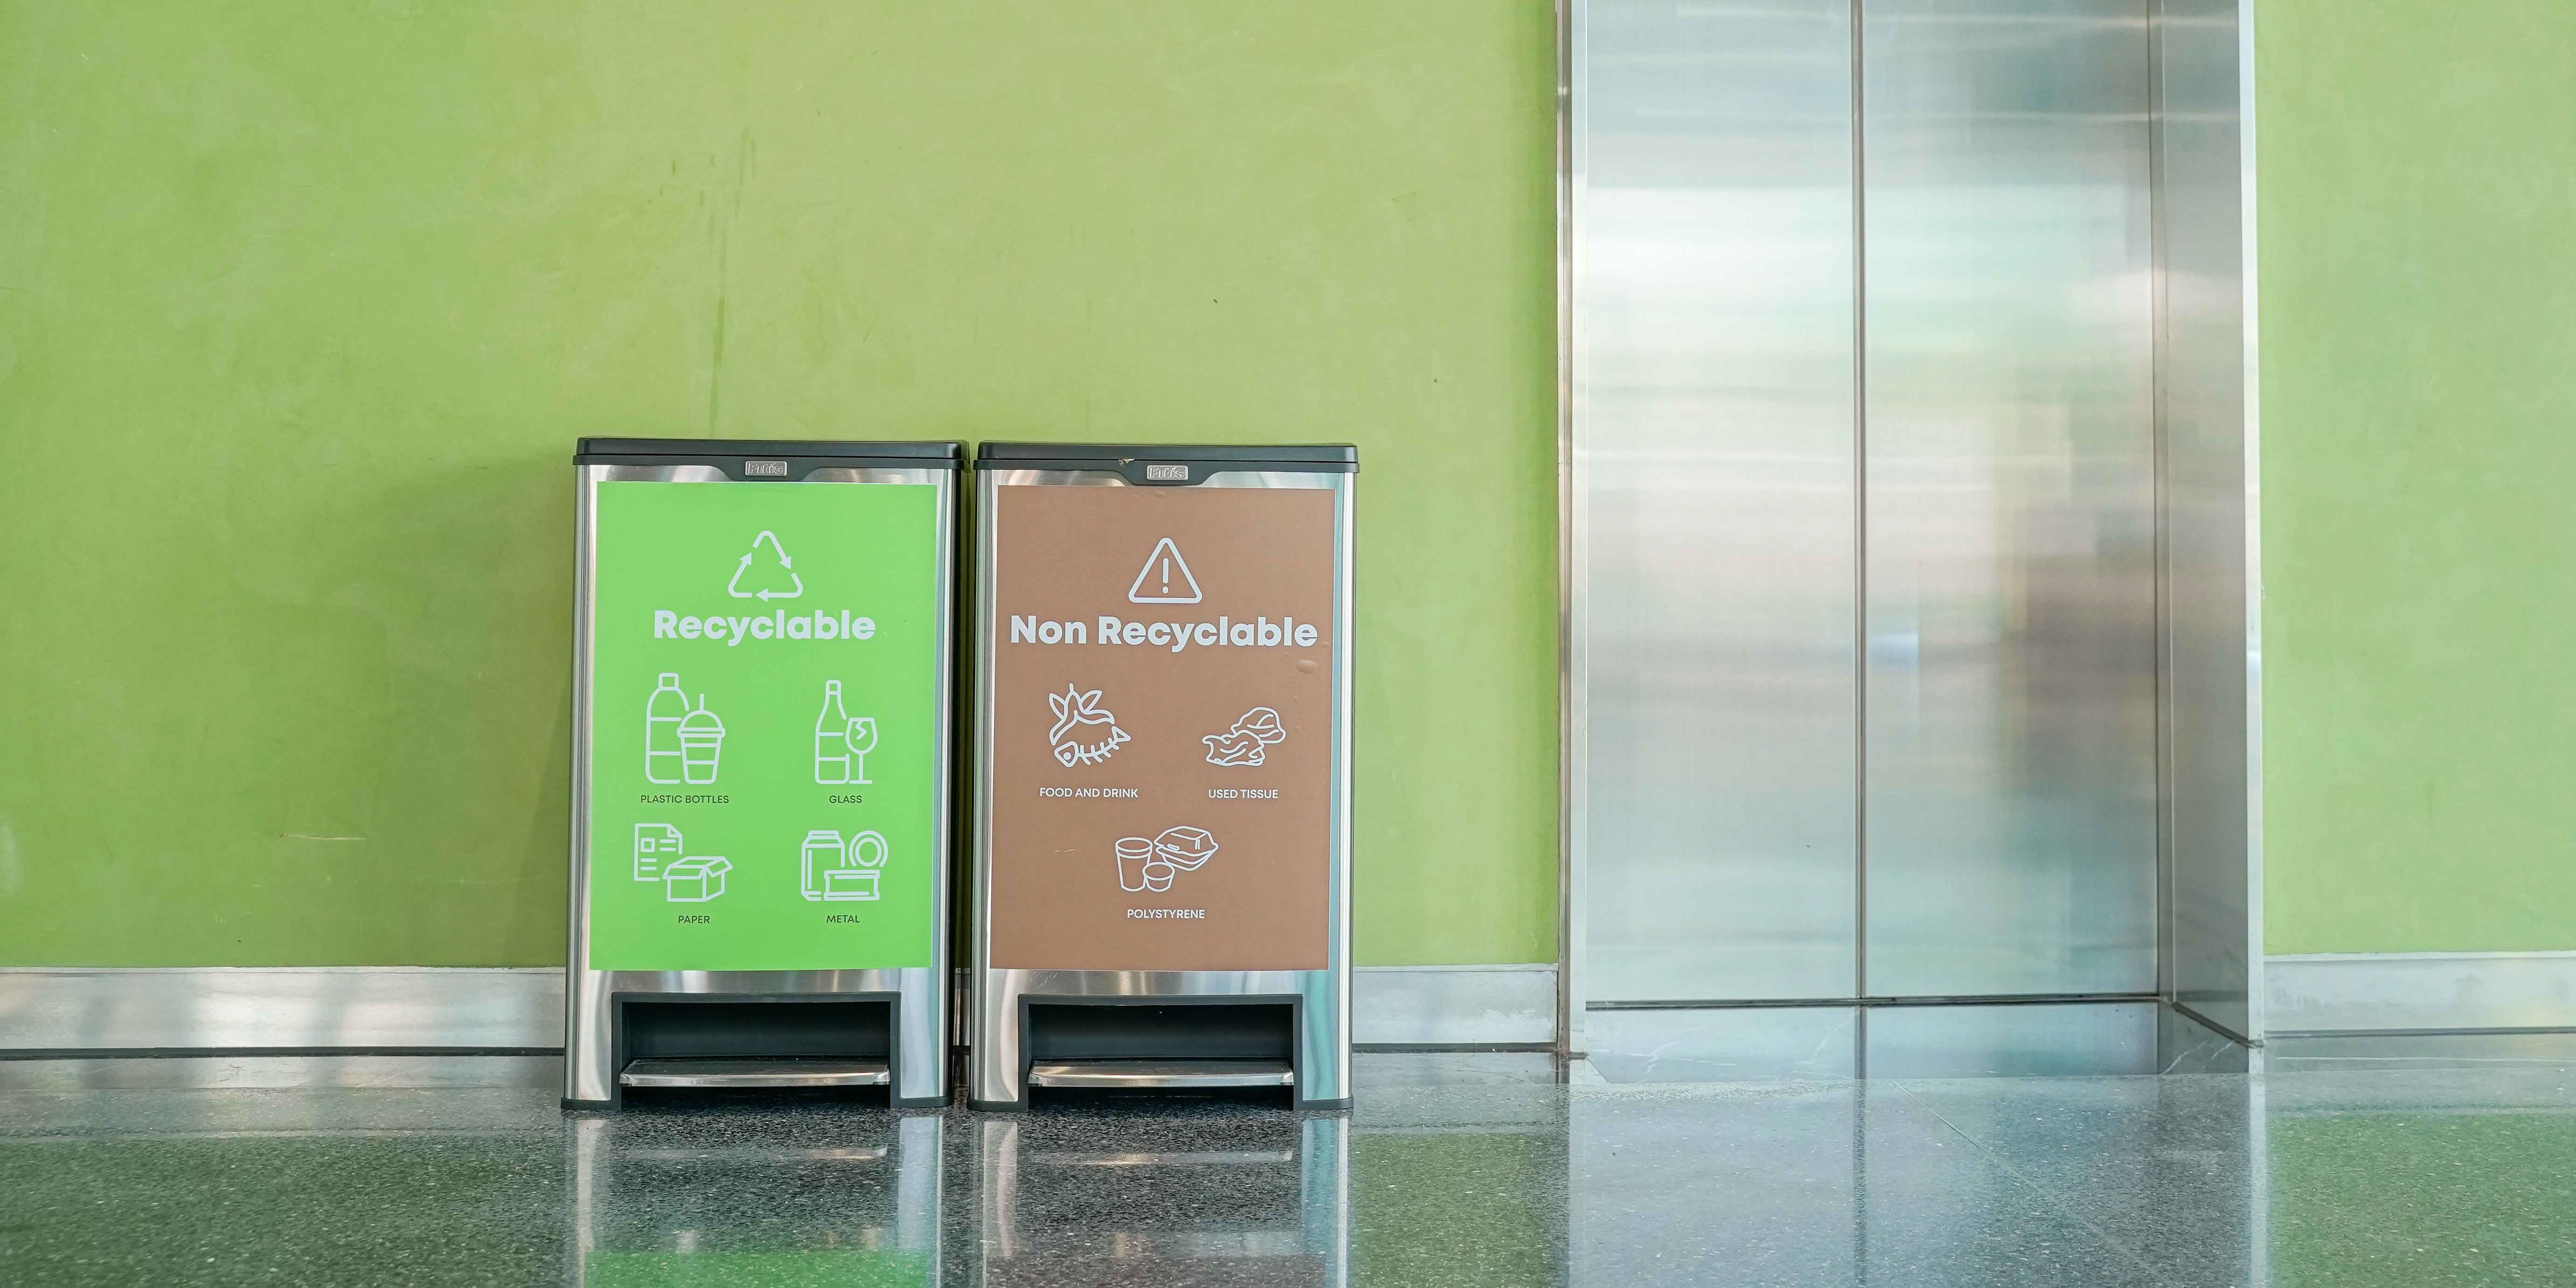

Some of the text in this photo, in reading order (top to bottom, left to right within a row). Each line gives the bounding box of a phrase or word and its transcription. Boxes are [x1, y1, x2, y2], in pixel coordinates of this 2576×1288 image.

[654, 609, 876, 647] Recyclable
[1010, 615, 1318, 653] Non Recyclable
[1039, 787, 1138, 798] FOOD AND DRINK
[1208, 789, 1278, 799] USED TISSUE
[640, 795, 729, 804] PLASTIC BOTTLES
[829, 795, 862, 804] GLASS
[826, 914, 860, 924] METAL
[1127, 909, 1205, 919] POLYSTYRENE
[678, 915, 710, 924] PAPER
